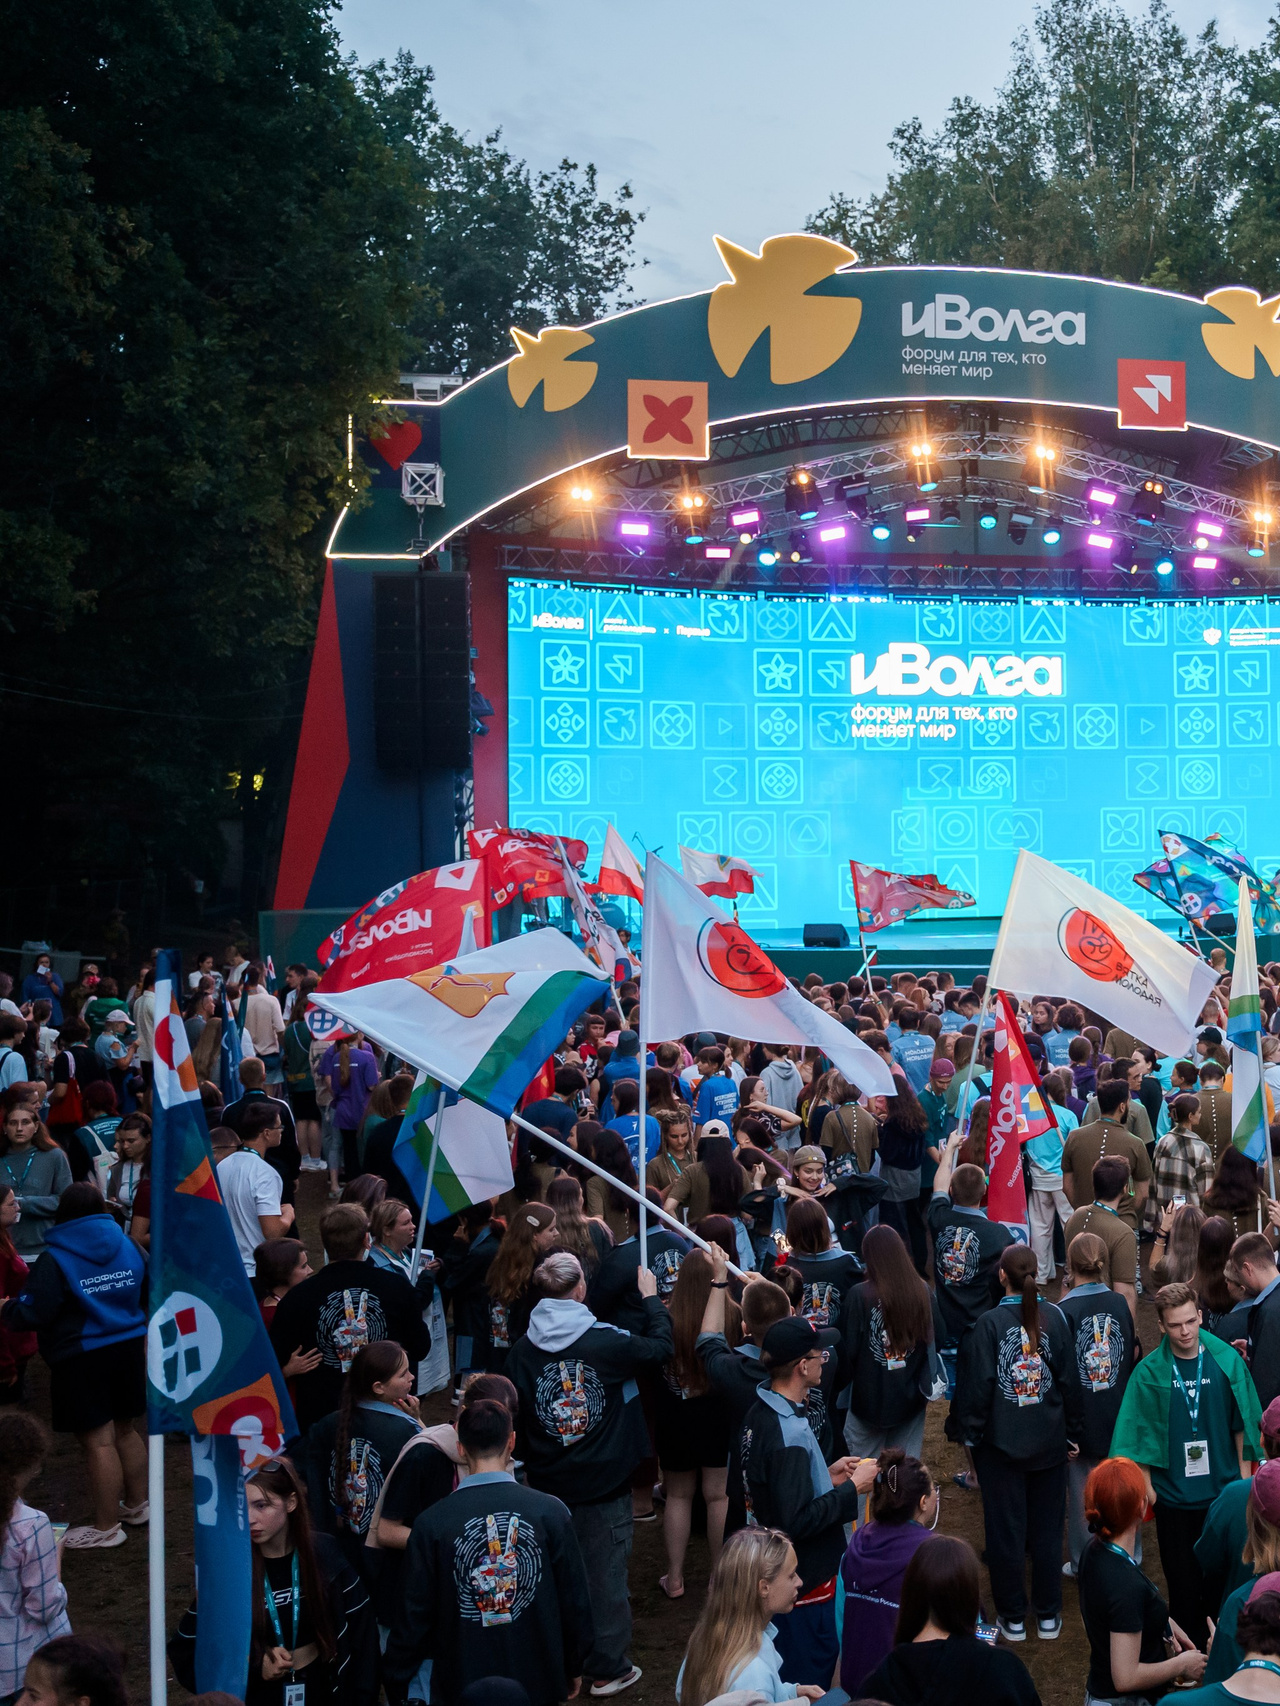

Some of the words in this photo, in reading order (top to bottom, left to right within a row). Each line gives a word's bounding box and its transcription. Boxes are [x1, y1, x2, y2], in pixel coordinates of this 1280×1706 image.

[902, 293, 1086, 345] иВолга
[902, 345, 954, 363] форум
[958, 350, 987, 363] для
[991, 352, 1018, 365] тех,
[1022, 353, 1046, 365] кто
[902, 363, 957, 376] меняет
[962, 366, 993, 380] мир
[850, 642, 1062, 697] иВолга
[851, 702, 913, 723] форум
[915, 706, 949, 721] для
[952, 706, 985, 722] тех,
[988, 706, 1017, 721] кто
[851, 723, 916, 738] меняет
[920, 724, 956, 741] мир
[1115, 961, 1149, 989] ВЯТКА
[1112, 973, 1162, 1008] МОЛОДАЯ
[80, 1269, 133, 1286] ПРОФКОМ
